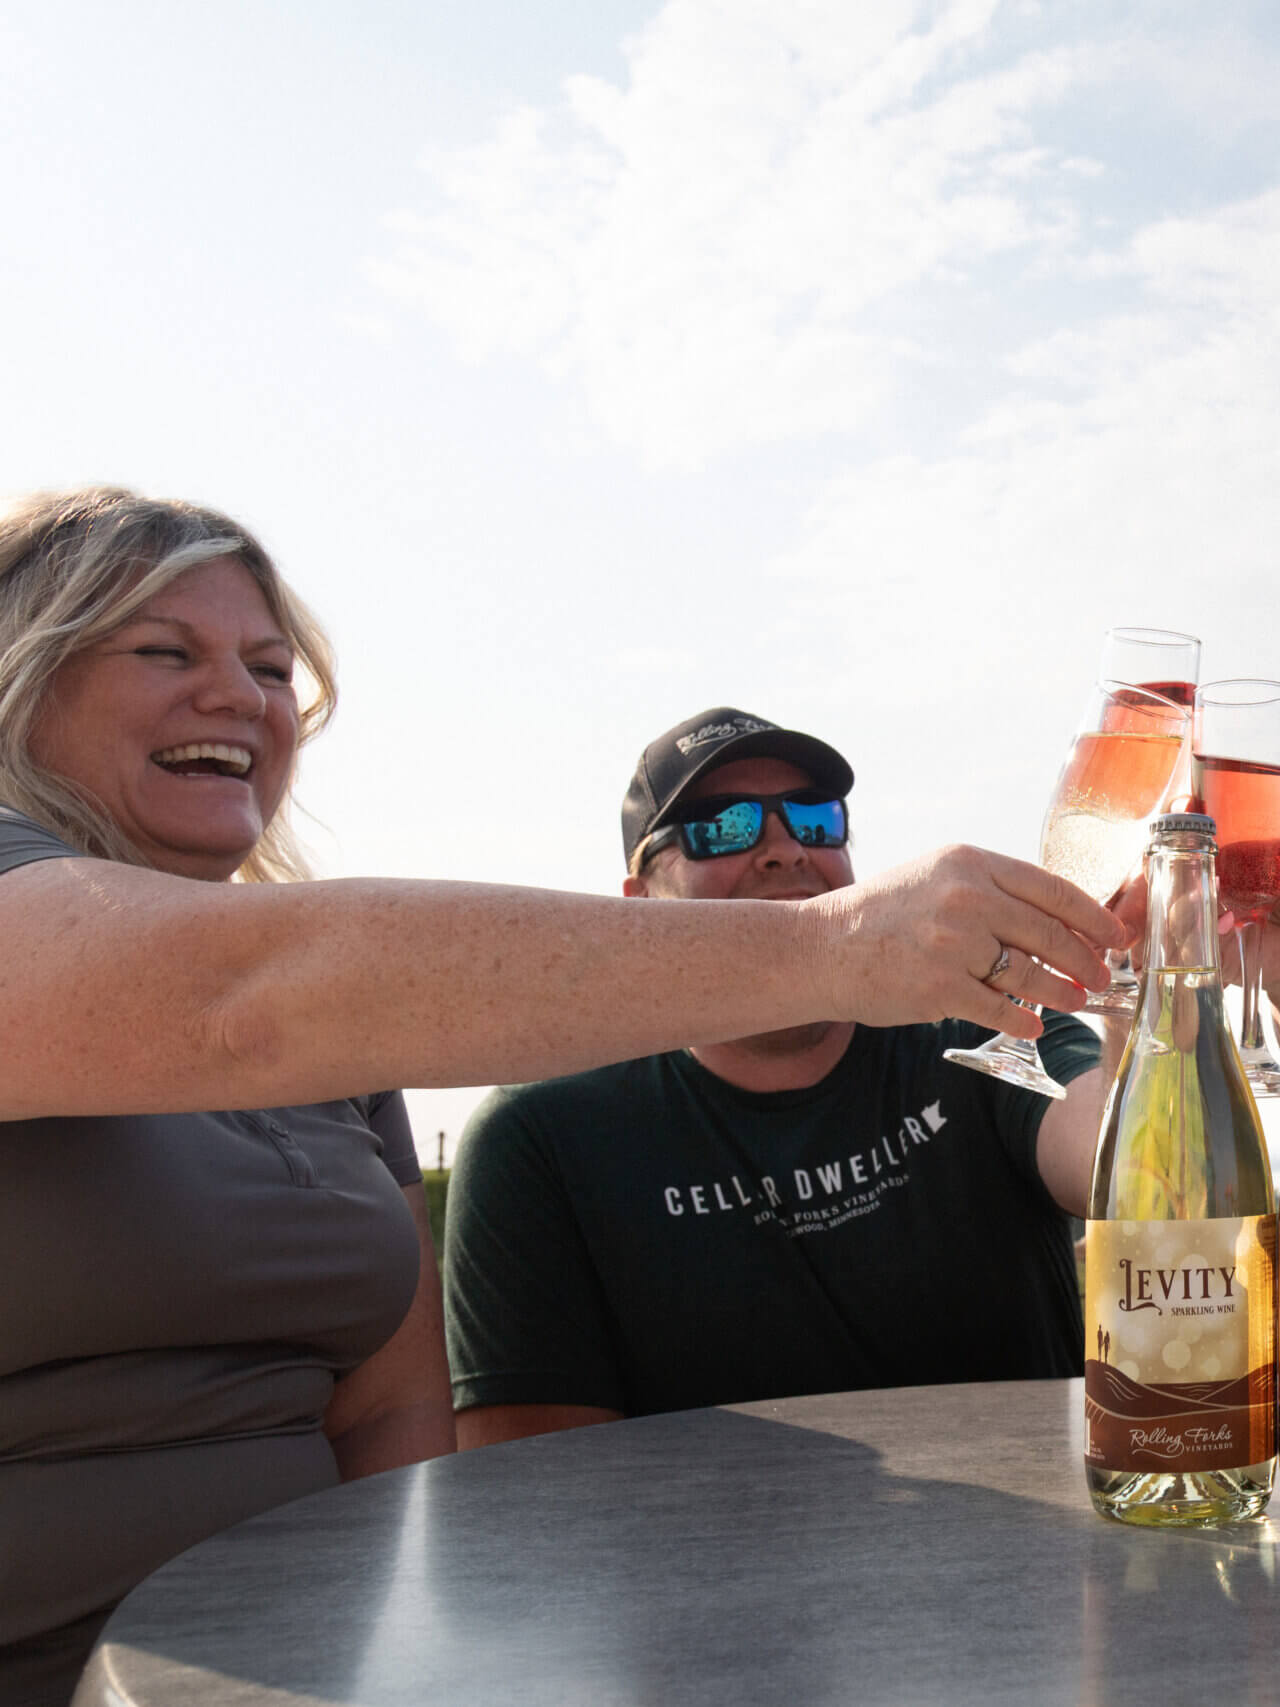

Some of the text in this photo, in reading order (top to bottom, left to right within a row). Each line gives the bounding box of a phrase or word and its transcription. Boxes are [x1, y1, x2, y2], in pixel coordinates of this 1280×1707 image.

[664, 1116, 930, 1216] CELLR DWELLER
[794, 1205, 840, 1223] FORKS
[1118, 1259, 1237, 1316] LEVITY
[1171, 1303, 1236, 1316] SPARKLING WINE
[1129, 1427, 1184, 1458] Rolling
[1184, 1424, 1233, 1444] Forks
[1185, 1442, 1233, 1452] VINEYARDS
